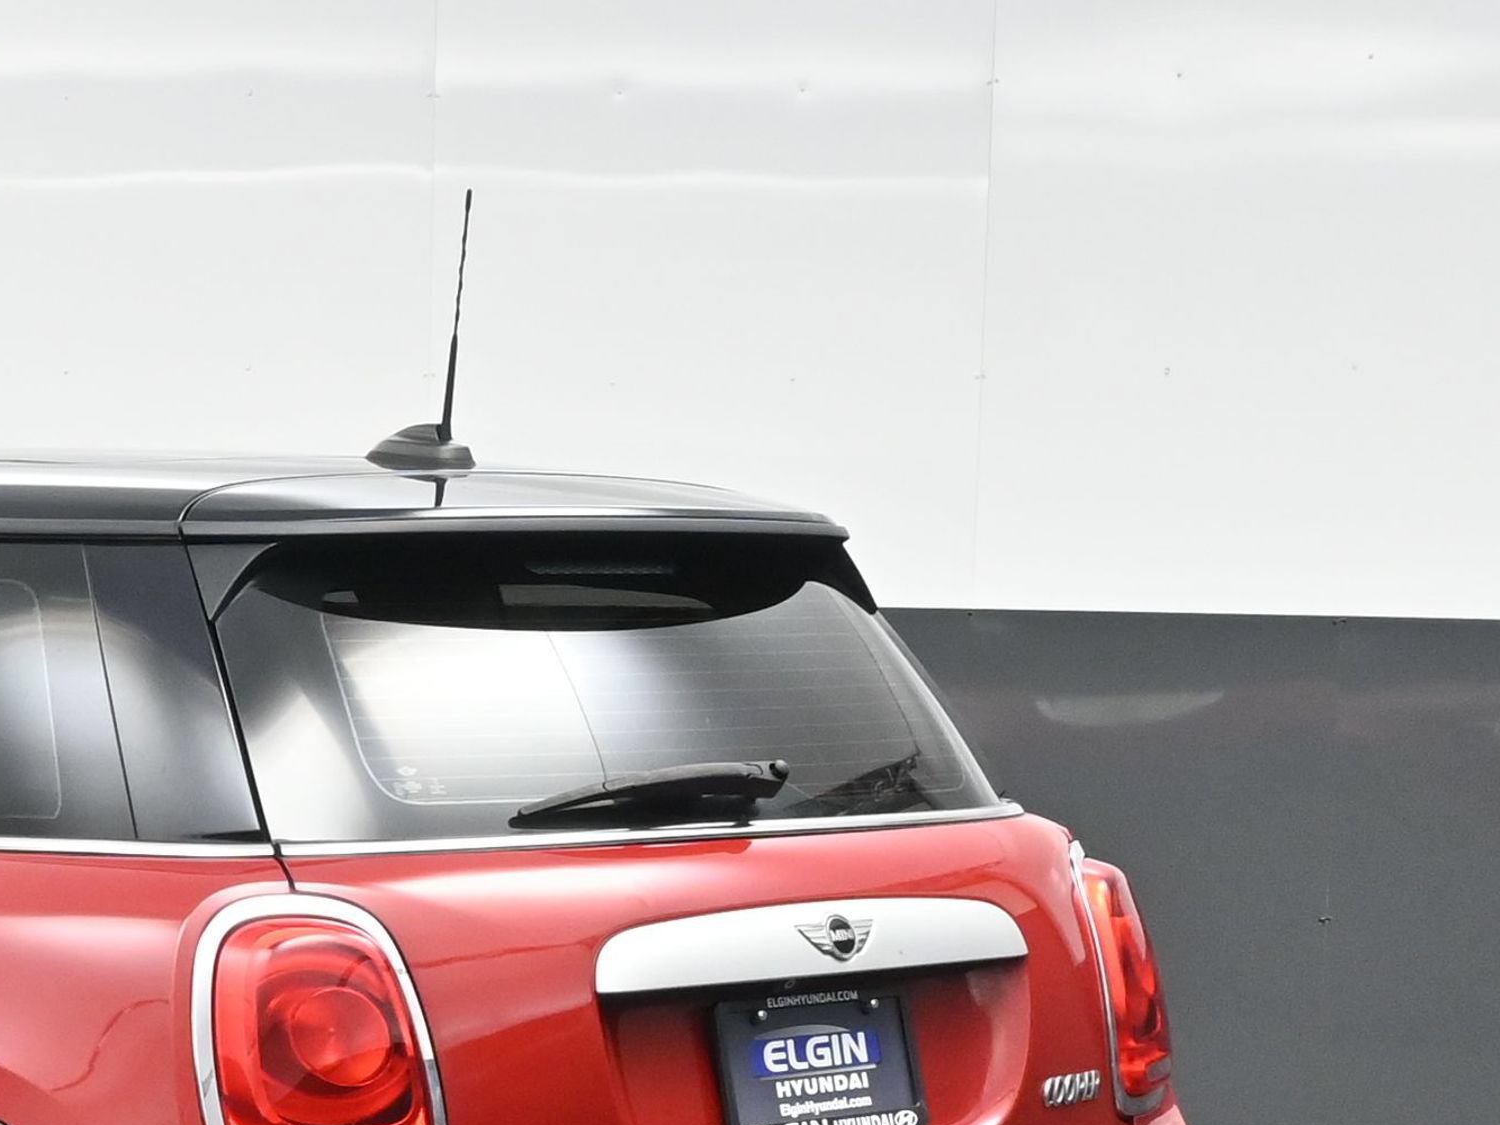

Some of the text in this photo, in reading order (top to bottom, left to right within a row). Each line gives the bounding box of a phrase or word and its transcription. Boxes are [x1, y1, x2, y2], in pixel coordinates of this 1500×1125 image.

[829, 928, 855, 942] MINI
[766, 990, 859, 1009] ELGINHYUNDAI.COM
[763, 1031, 868, 1073] ELGIN
[775, 1072, 870, 1099] HYUNDAI
